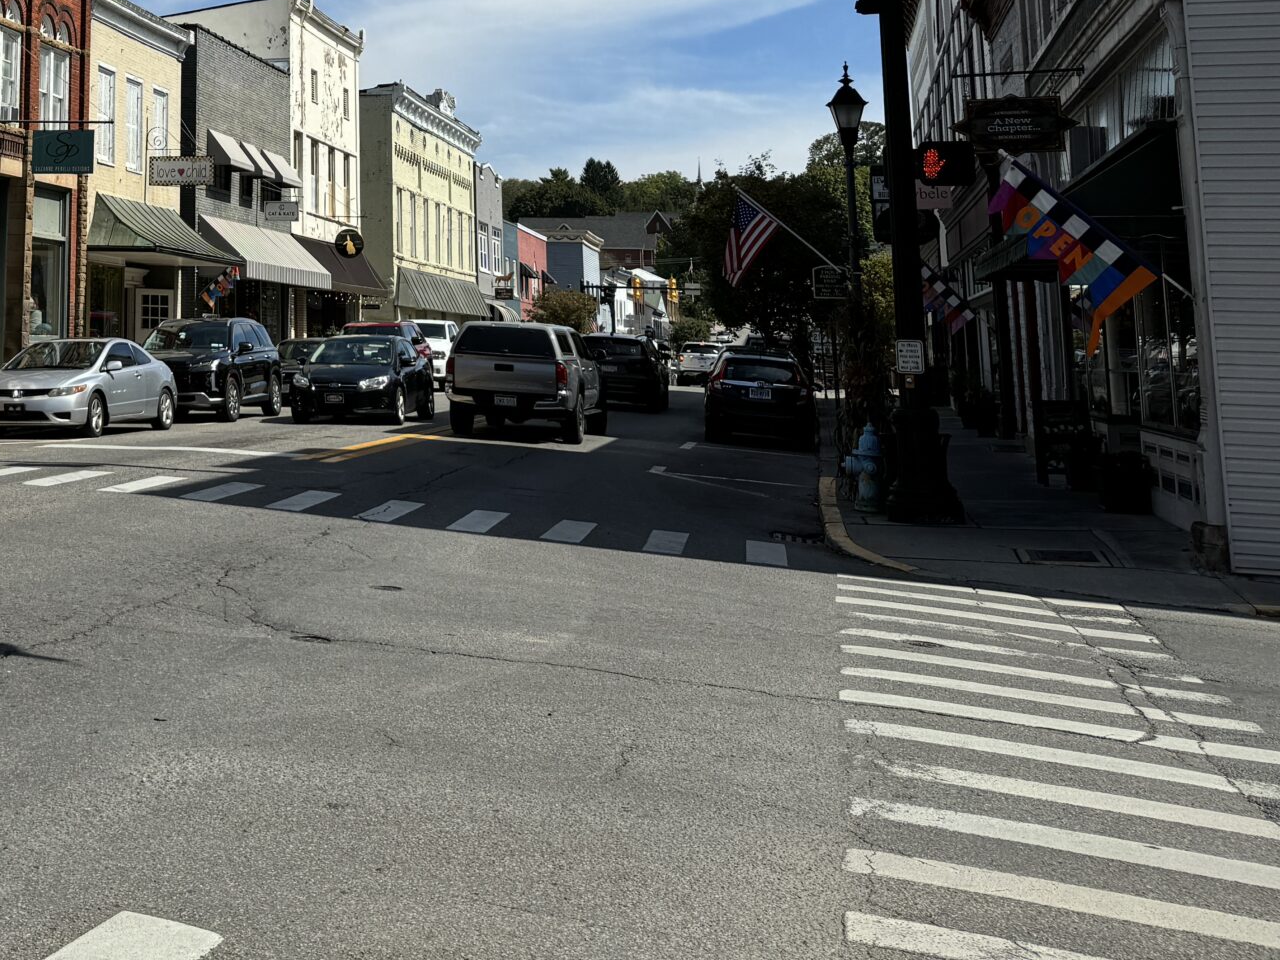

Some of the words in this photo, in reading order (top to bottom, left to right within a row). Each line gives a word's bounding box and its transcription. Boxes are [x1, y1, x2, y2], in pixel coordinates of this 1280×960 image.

[1004, 117, 1032, 125] New
[156, 164, 176, 178] love
[185, 163, 207, 178] child
[917, 187, 948, 199] bele
[1015, 207, 1095, 272] OPEN
